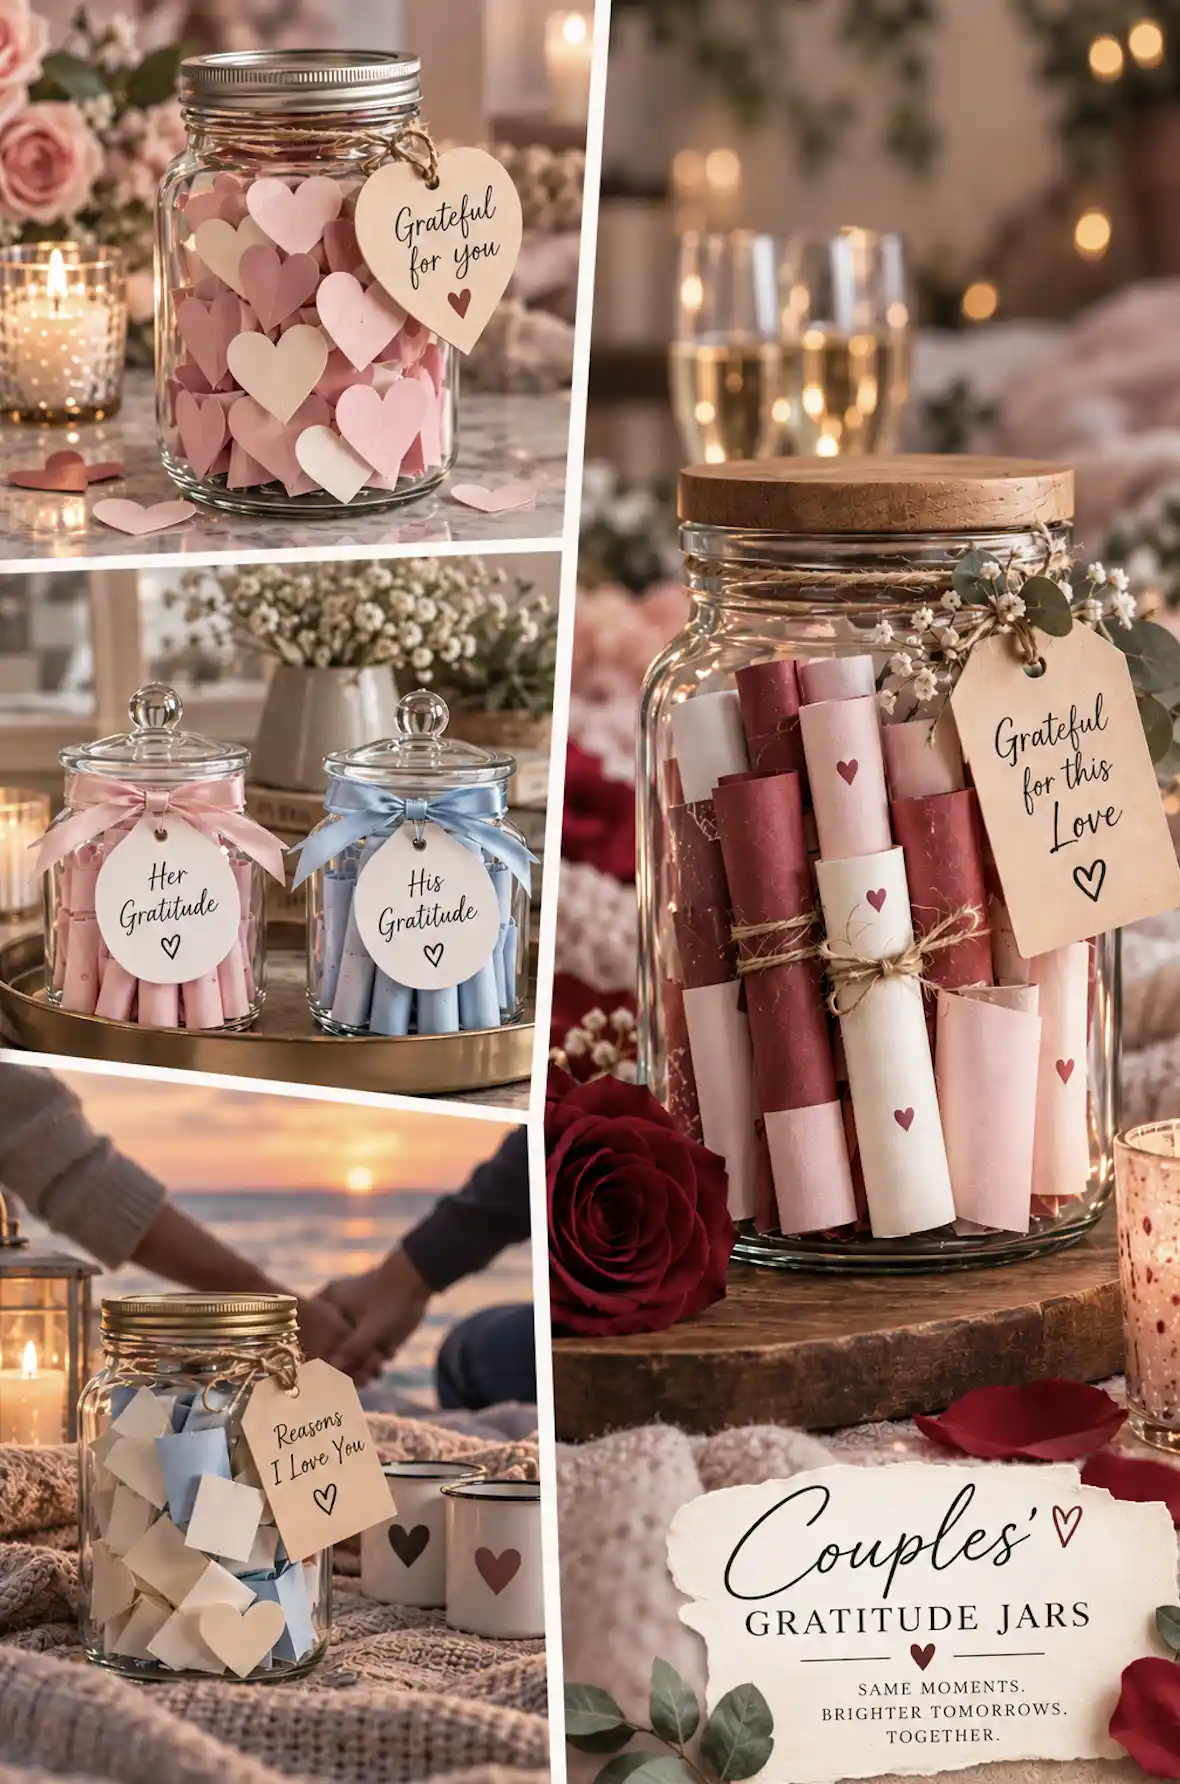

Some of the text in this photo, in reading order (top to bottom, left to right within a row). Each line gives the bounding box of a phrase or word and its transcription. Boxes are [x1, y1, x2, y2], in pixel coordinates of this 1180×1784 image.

[395, 184, 497, 248] Grateful
[408, 241, 501, 290] for you
[995, 692, 1110, 766] Grateful
[1023, 750, 1114, 816] for this
[1050, 801, 1122, 854] Love
[149, 862, 188, 891] Her
[408, 868, 444, 897] His
[119, 888, 219, 936] Gratitude
[378, 895, 478, 943] Gratitude
[273, 1411, 345, 1449] Reasons
[271, 1435, 366, 1485] I Love You
